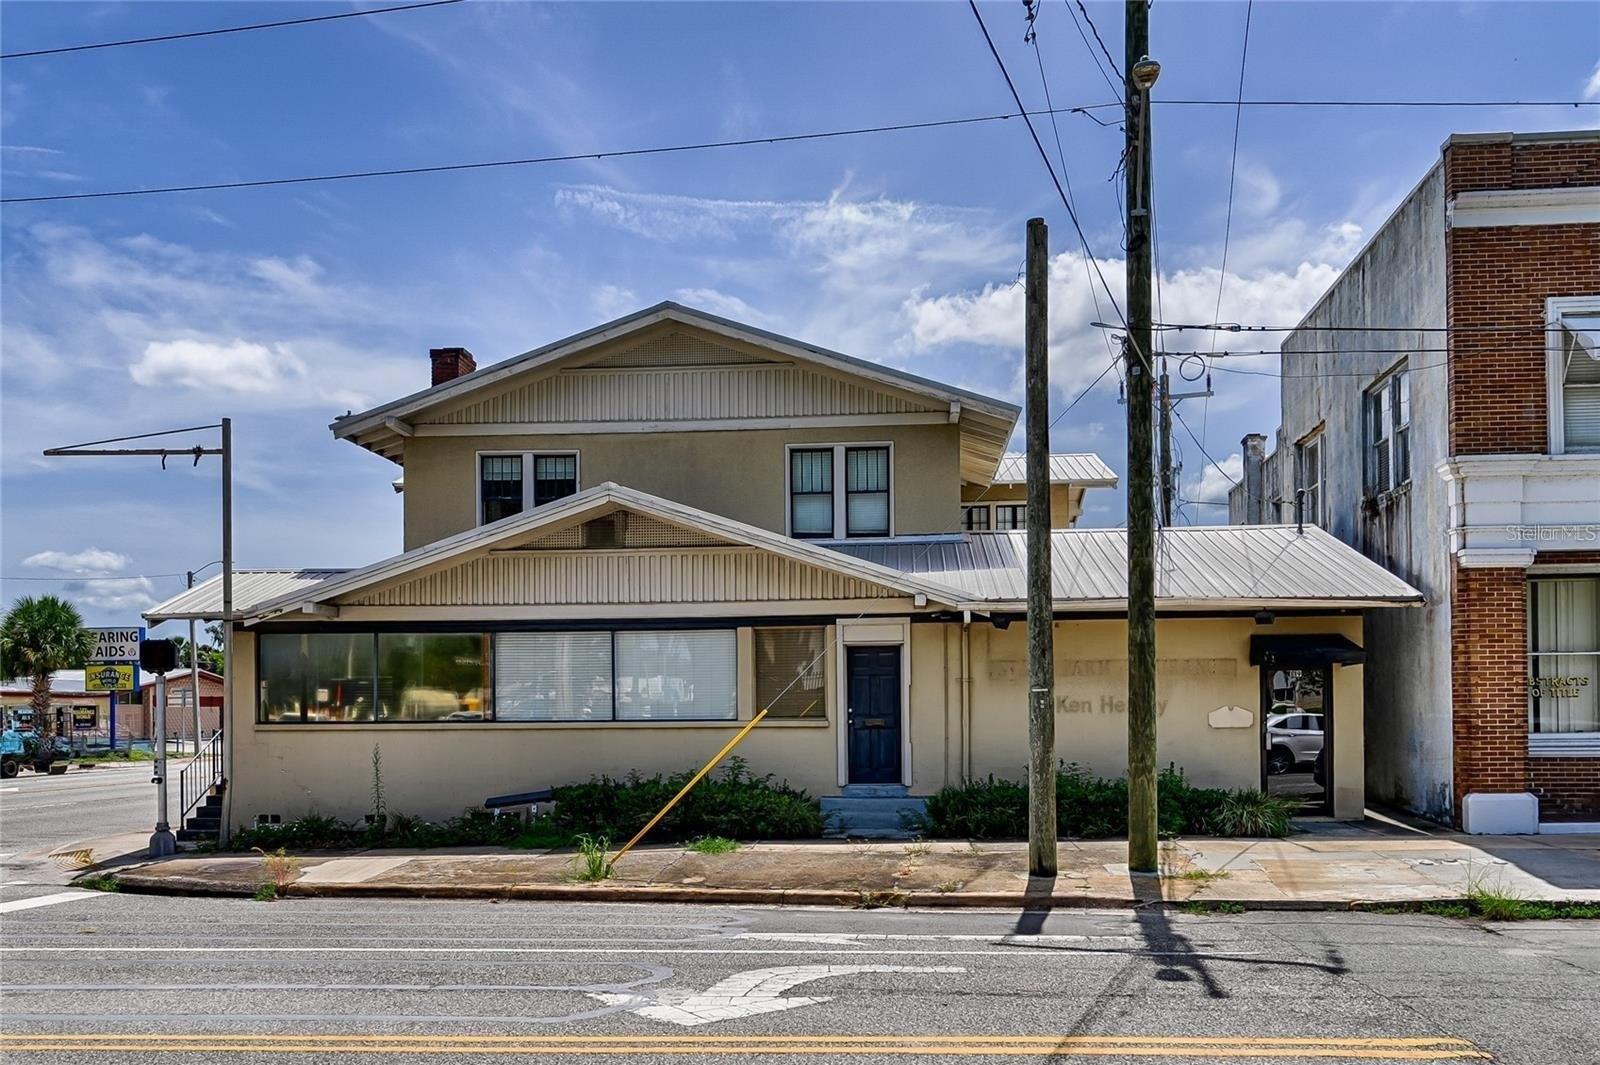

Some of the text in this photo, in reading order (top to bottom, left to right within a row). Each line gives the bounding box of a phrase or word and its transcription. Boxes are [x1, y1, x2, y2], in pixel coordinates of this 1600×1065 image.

[95, 646, 126, 657] AIDS
[89, 671, 131, 681] INSURANCE
[1528, 676, 1590, 687] BSTRACTS
[1532, 688, 1580, 698] OF TITLE
[1056, 695, 1092, 713] Ken
